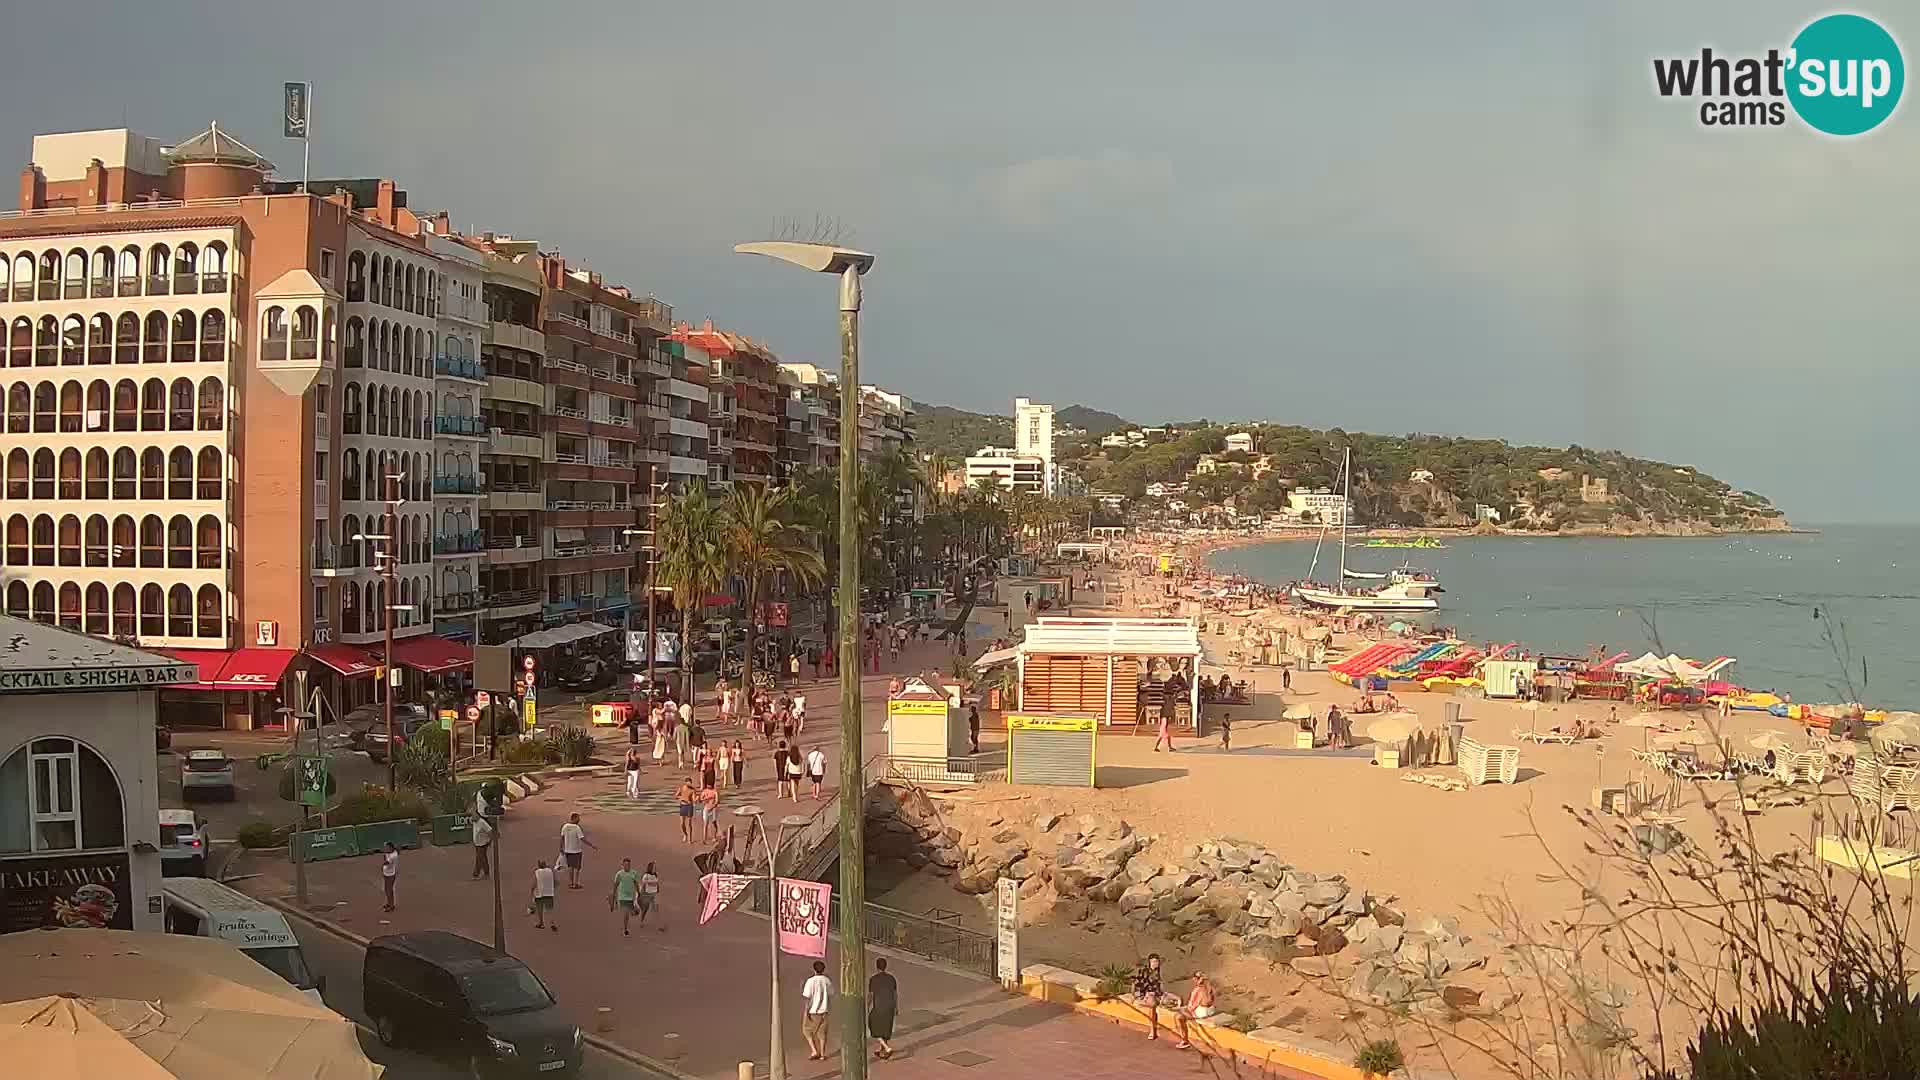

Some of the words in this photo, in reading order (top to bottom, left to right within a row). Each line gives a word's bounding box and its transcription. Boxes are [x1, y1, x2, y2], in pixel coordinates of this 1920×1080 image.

[314, 628, 333, 643] KFC
[64, 671, 75, 686] &
[80, 669, 141, 685] SHISHA
[146, 667, 179, 682] BAR
[230, 673, 268, 682] KFC
